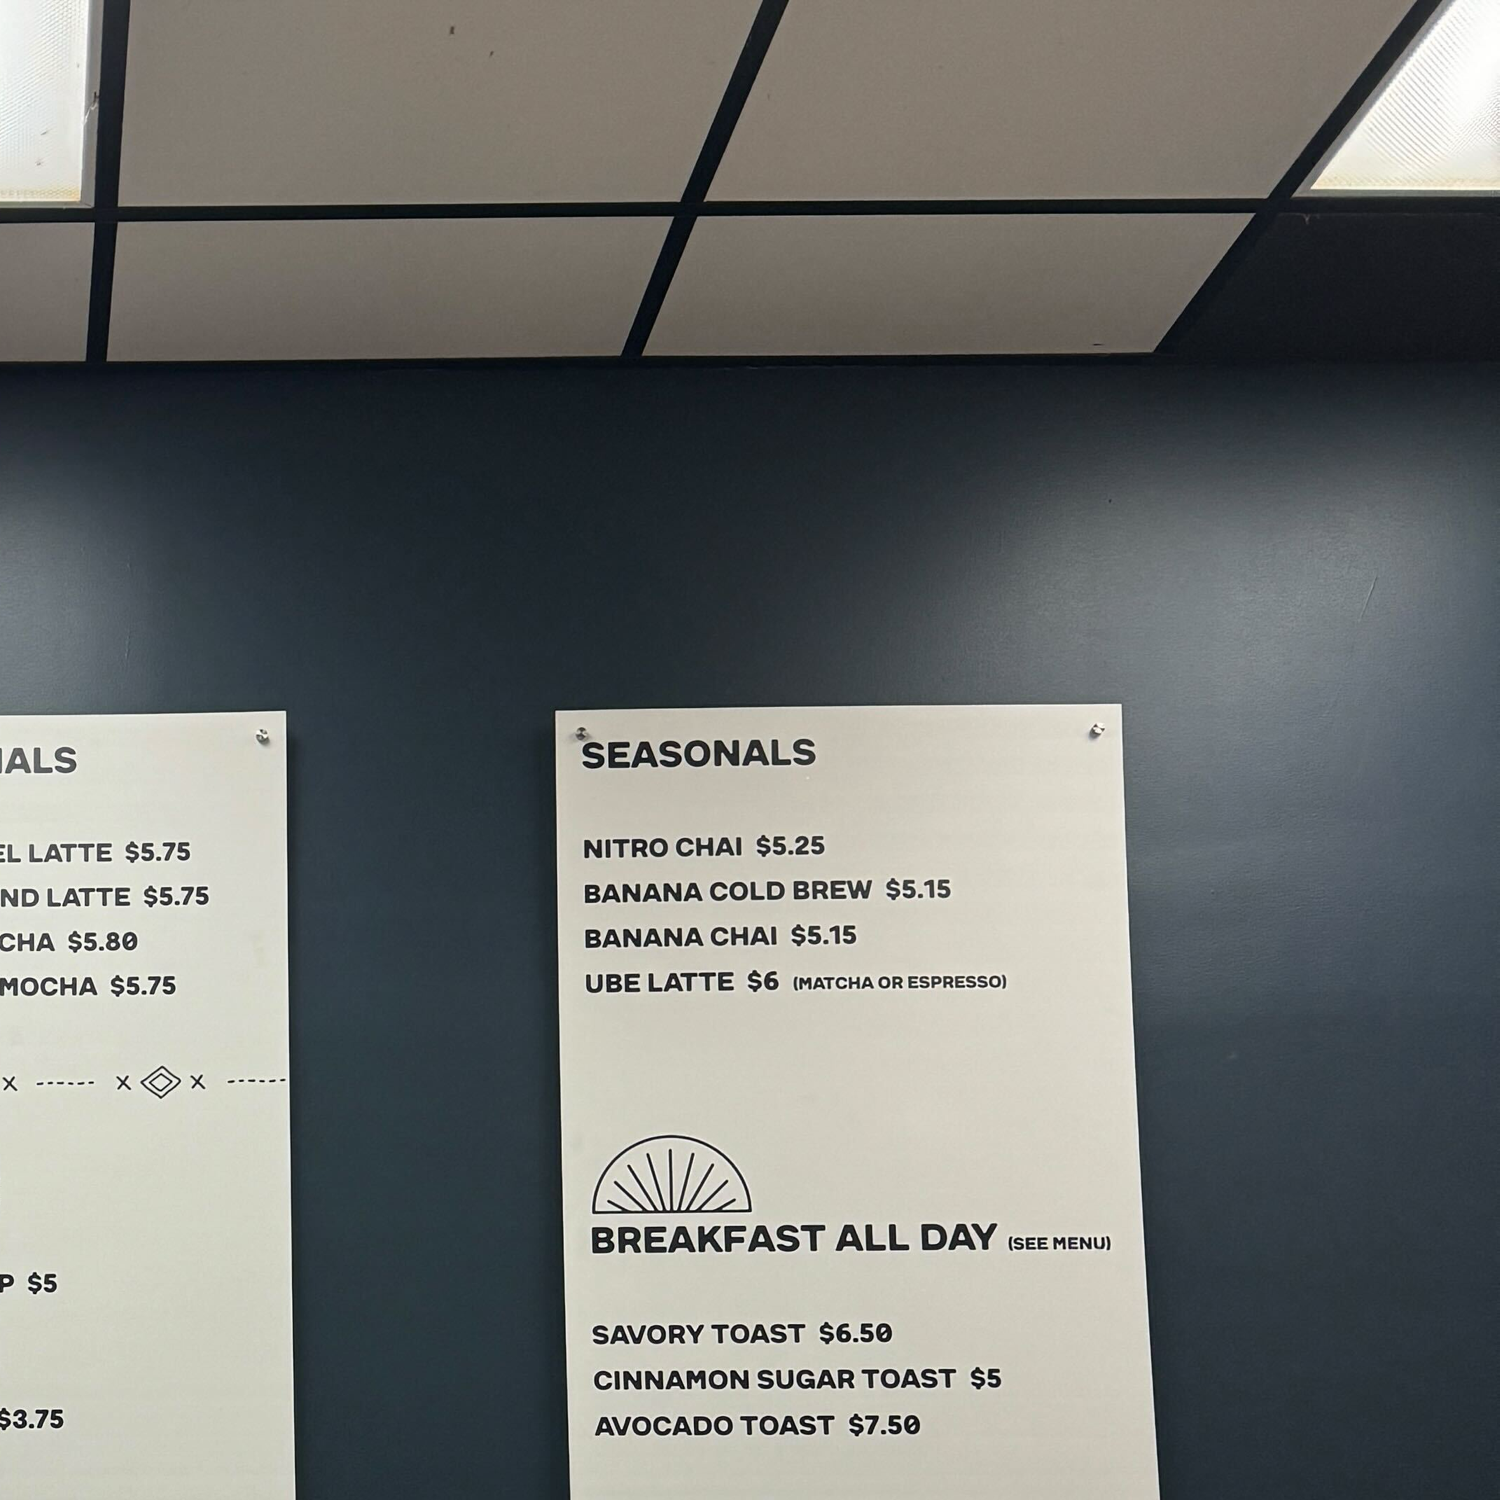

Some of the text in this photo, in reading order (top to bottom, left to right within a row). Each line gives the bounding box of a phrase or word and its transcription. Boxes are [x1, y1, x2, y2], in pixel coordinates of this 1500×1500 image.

[582, 738, 816, 770] SEASONALS
[28, 842, 113, 863] LATTE
[125, 840, 191, 864] $5.75
[583, 834, 825, 859] NITRO CHAI $5.25
[47, 887, 131, 908] LATTE
[143, 885, 210, 908] $5.75
[584, 877, 951, 904] BANANA COLD BREW $5.15
[67, 930, 138, 954] $5.80
[584, 923, 857, 949] BANANA CHAI $5.15
[0, 976, 98, 997] MOCHA
[110, 974, 177, 998] $5.75
[585, 969, 1007, 994] UBE LATTE $6 (MATCHA OR ESPRESSO)
[591, 1222, 1111, 1254] BREAKFAST ALL DAY (SEE MENU)
[27, 1271, 58, 1295] $5
[592, 1321, 893, 1345] SAVORY TOAST $6.50
[593, 1366, 1002, 1391] CINNAMON SUGAR TOAST $5
[594, 1413, 921, 1437] AVOCADO TOAST $7.50
